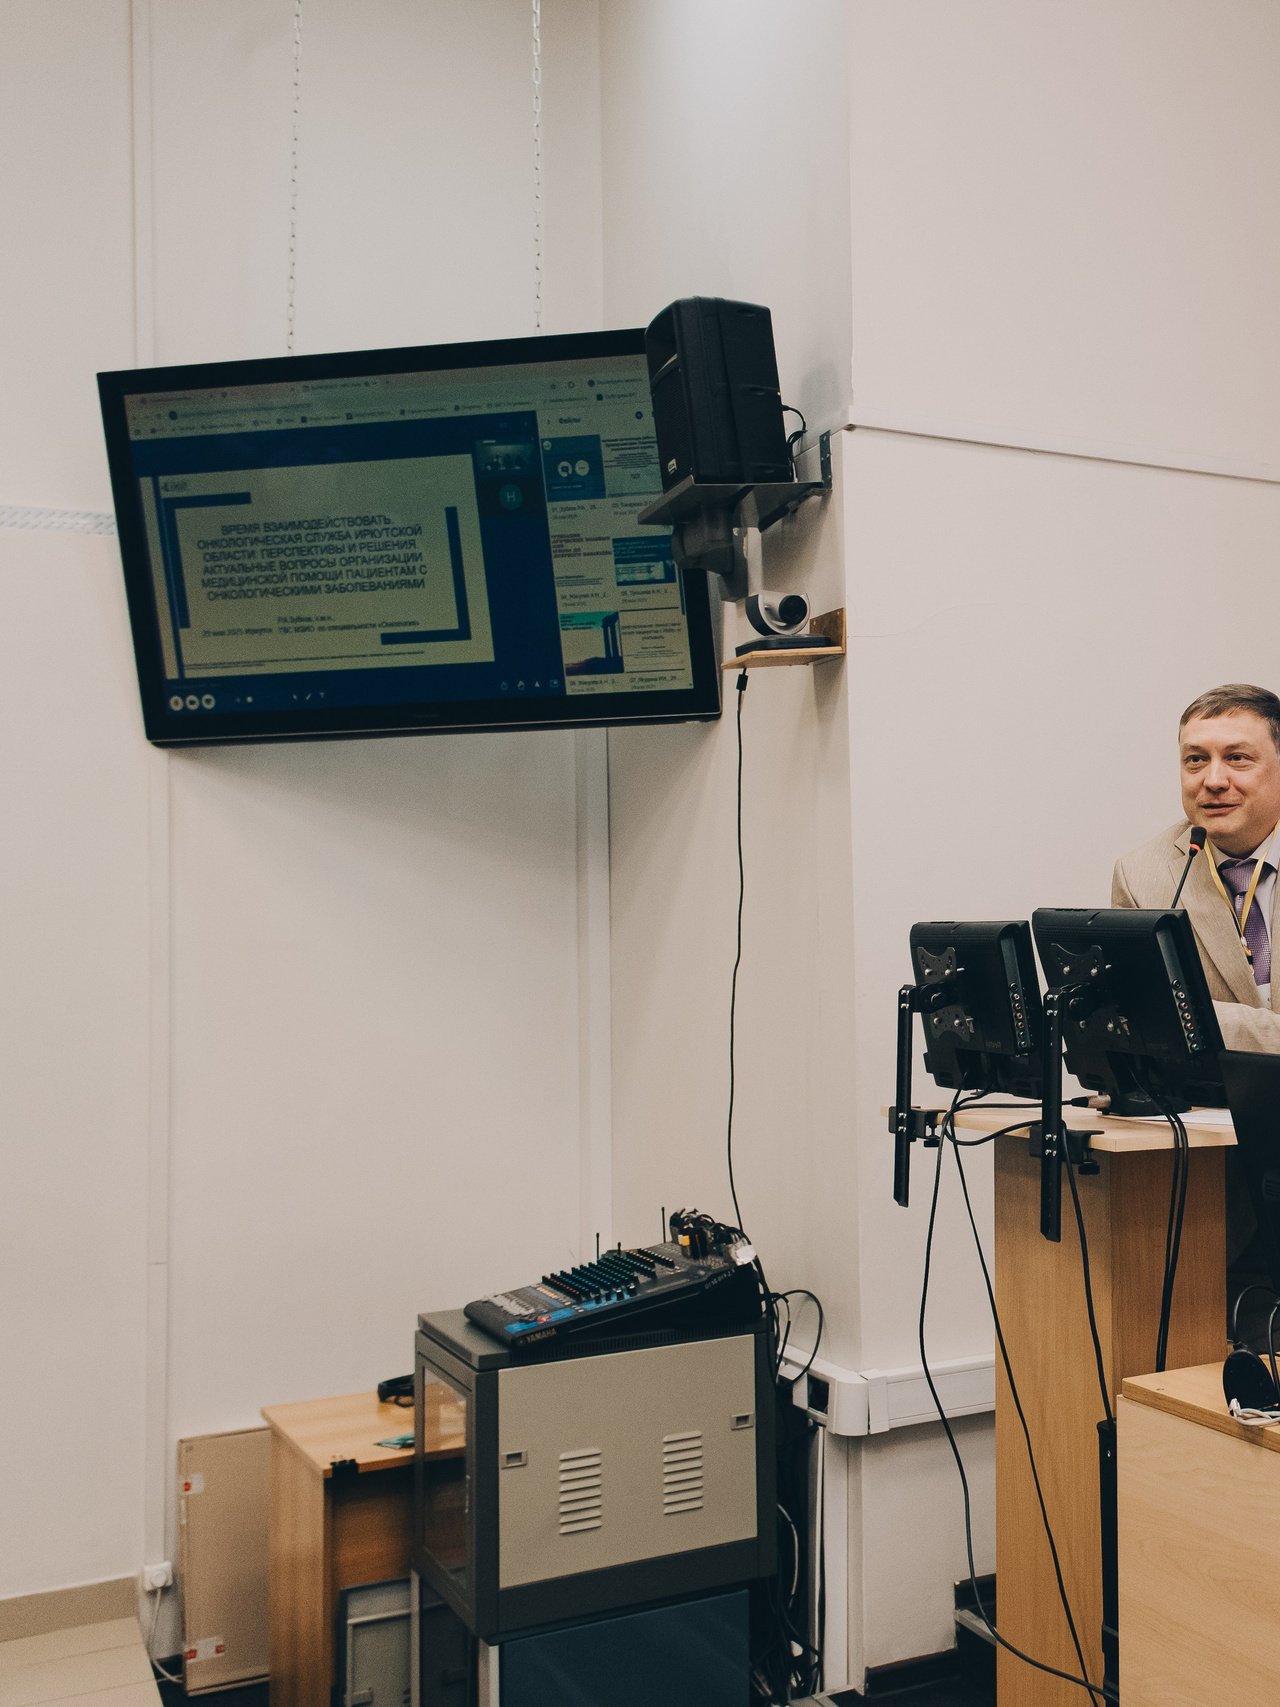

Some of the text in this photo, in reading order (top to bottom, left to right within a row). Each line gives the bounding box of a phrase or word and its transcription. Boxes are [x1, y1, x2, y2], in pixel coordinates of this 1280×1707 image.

[197, 523, 422, 550] ОНКОЛОГИЧЕСКАЯ СЛУЖБА ИРКУТСКОЙ
[221, 523, 260, 535] ВРЕМЯ
[260, 544, 345, 558] ПЕРСПЕКТИВЫ
[348, 543, 356, 553] И
[203, 552, 423, 575] АКТУАЛЬНЫЕ ВОПРОСЫ ОРГАНИЗАЦИИ
[201, 564, 428, 588] МЕДИЦИНСКОЙ ПОМОЩИ ПАЦИЕНТАМ С
[207, 578, 425, 601] ОНКОЛОГИЧЕСКИМИ ЗАБОЛЕВАНИЯМИ
[526, 1328, 557, 1343] YAMAHA
